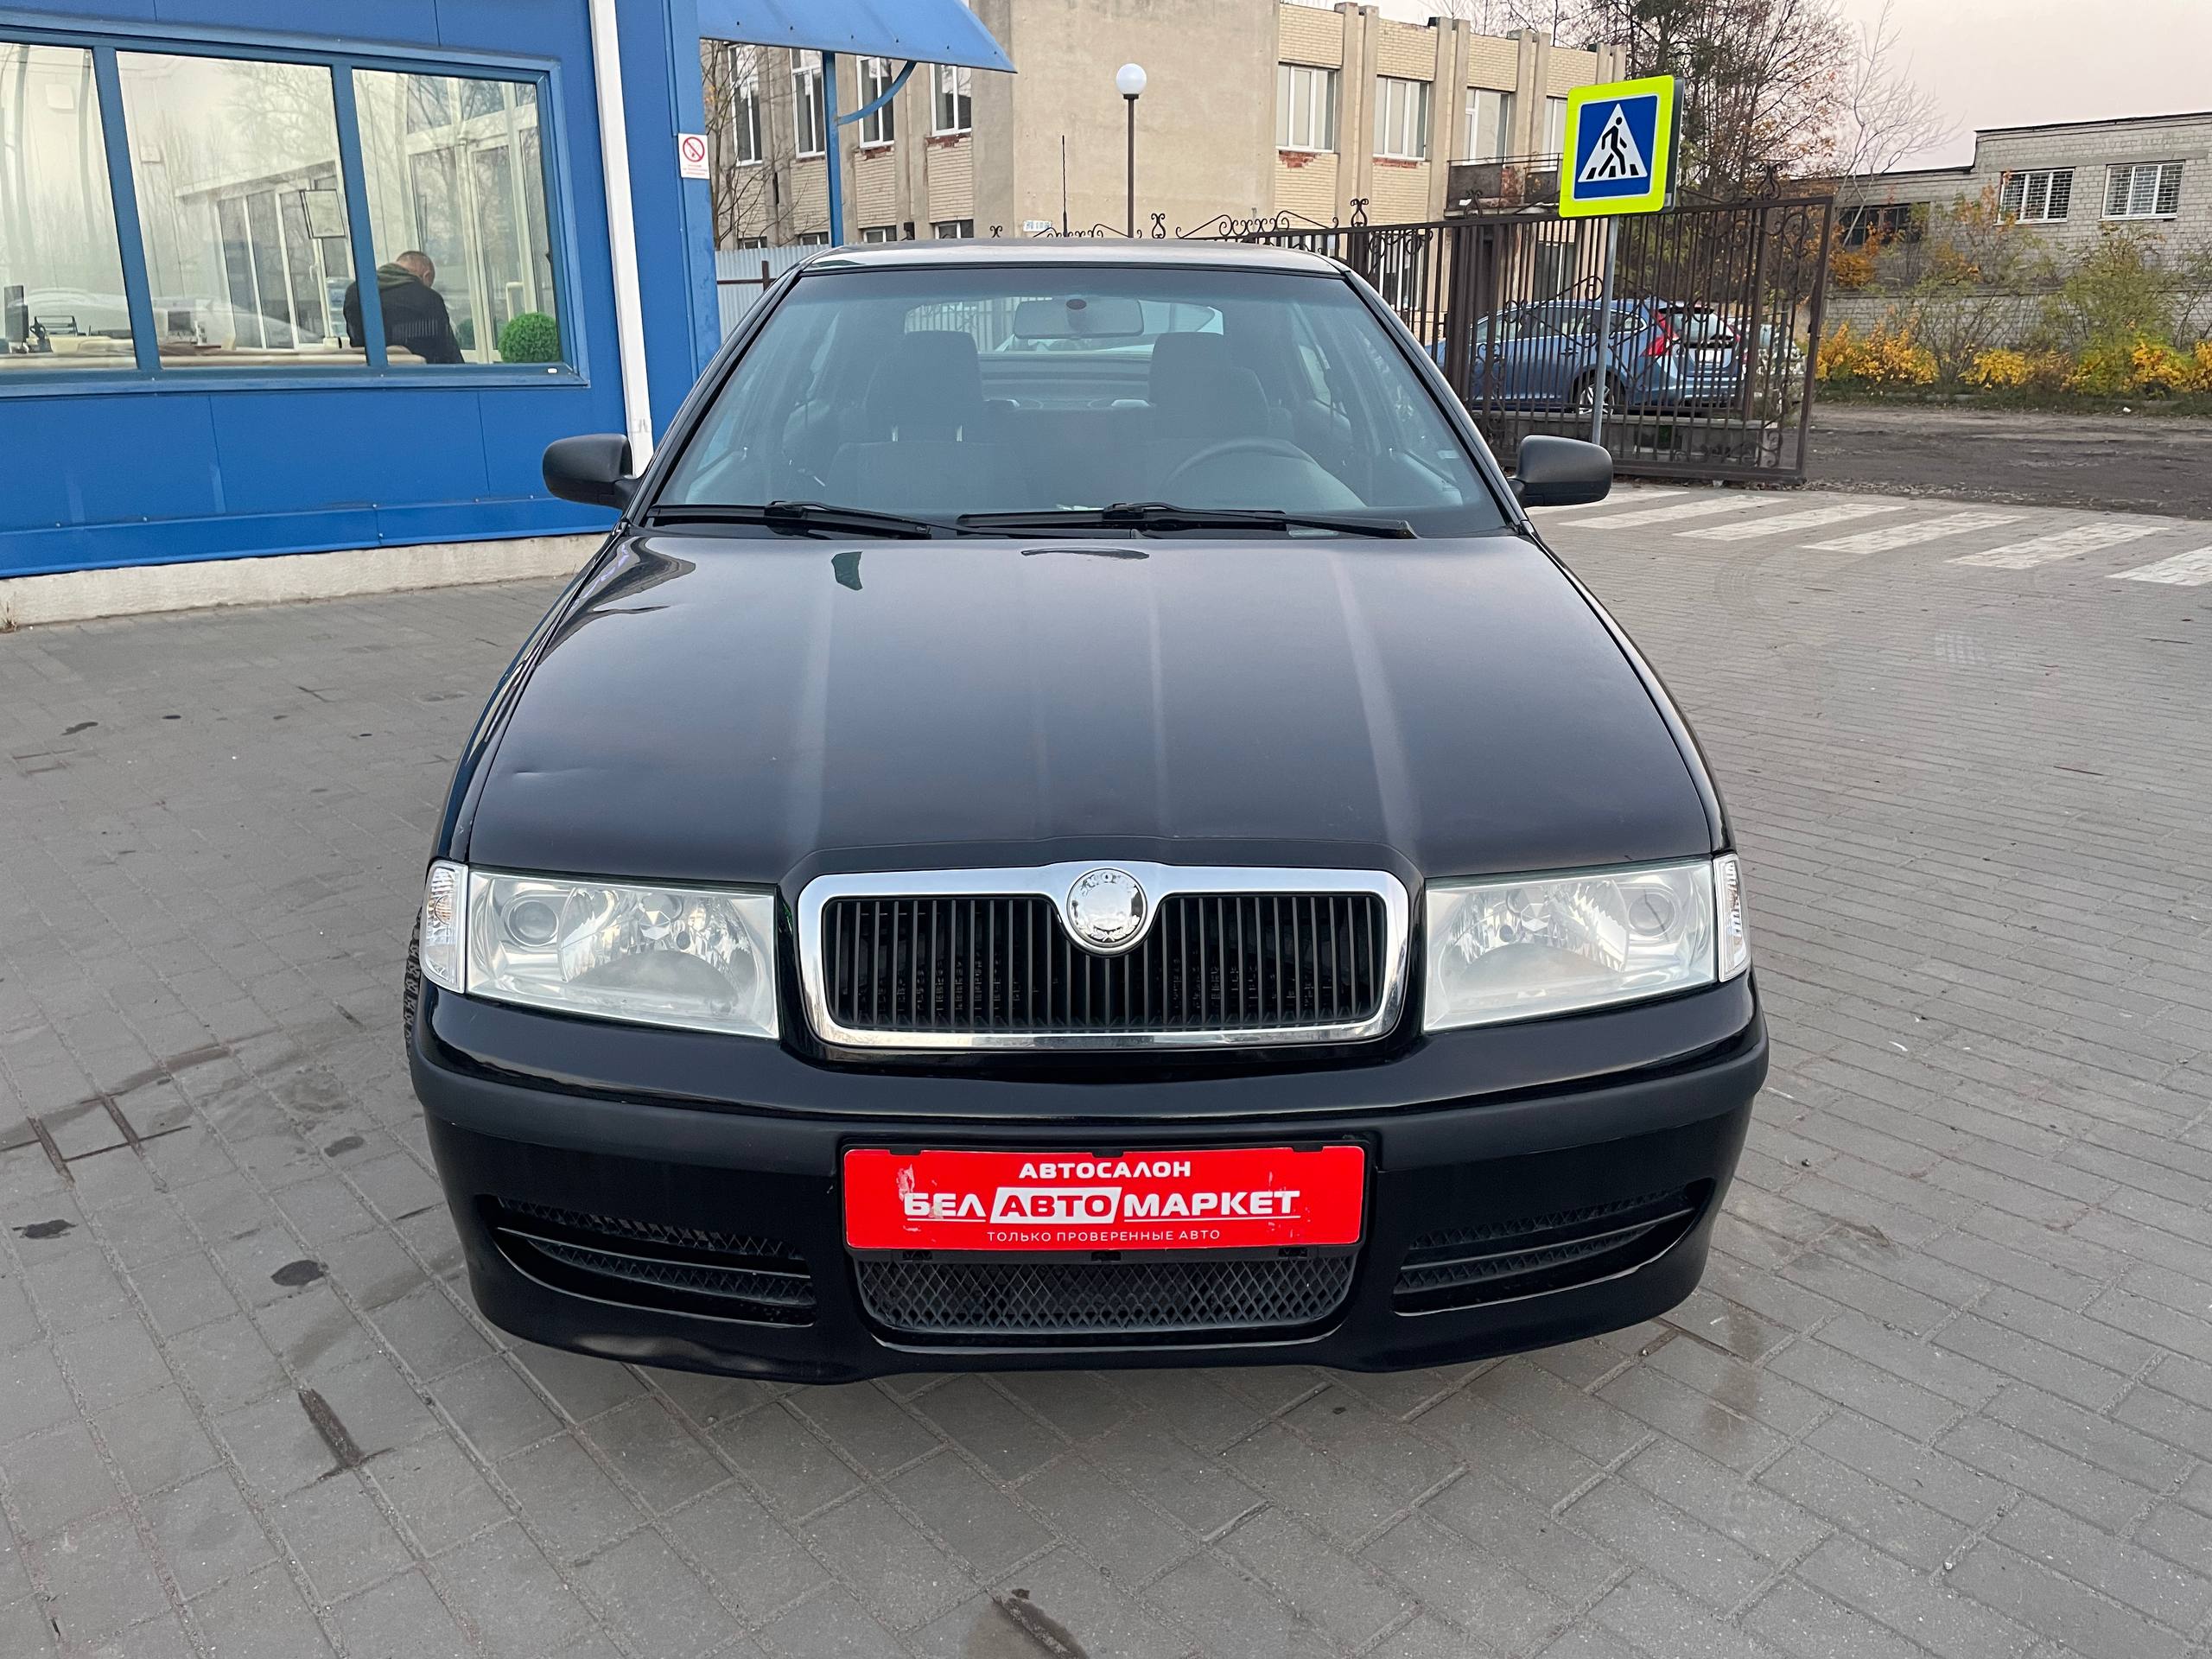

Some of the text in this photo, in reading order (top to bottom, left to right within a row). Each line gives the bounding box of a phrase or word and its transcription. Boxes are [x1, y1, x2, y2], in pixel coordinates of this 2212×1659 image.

[1018, 1161, 1192, 1179] АВТОСАЛОН
[987, 1230, 1220, 1243] ТОЛЬКО ПРОВЕРЕННЫЕ АВТО
